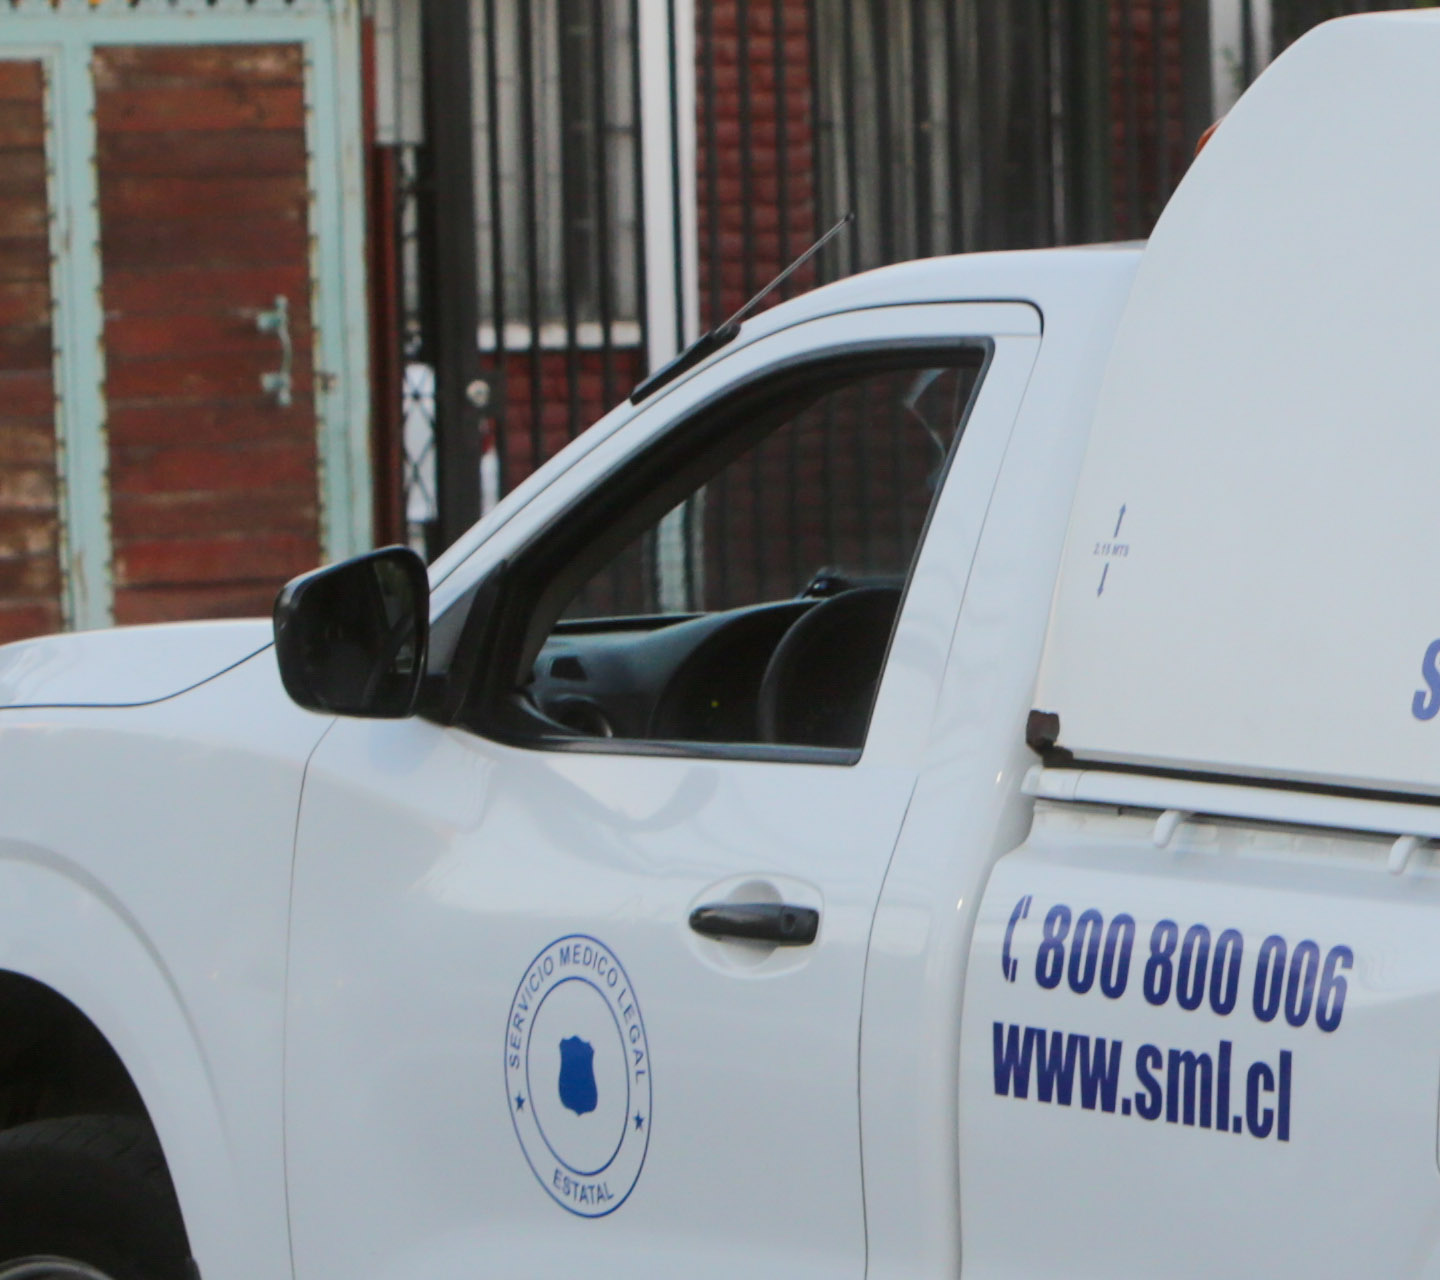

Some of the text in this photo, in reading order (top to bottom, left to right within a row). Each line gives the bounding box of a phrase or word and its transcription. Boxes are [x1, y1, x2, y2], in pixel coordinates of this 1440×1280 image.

[509, 943, 646, 1084] SERVICIO MEDICO LEGAL
[1035, 904, 1354, 1033] 800 800 006
[993, 1021, 1293, 1142] www.sml.cl
[553, 1167, 615, 1206] ESTATAL
